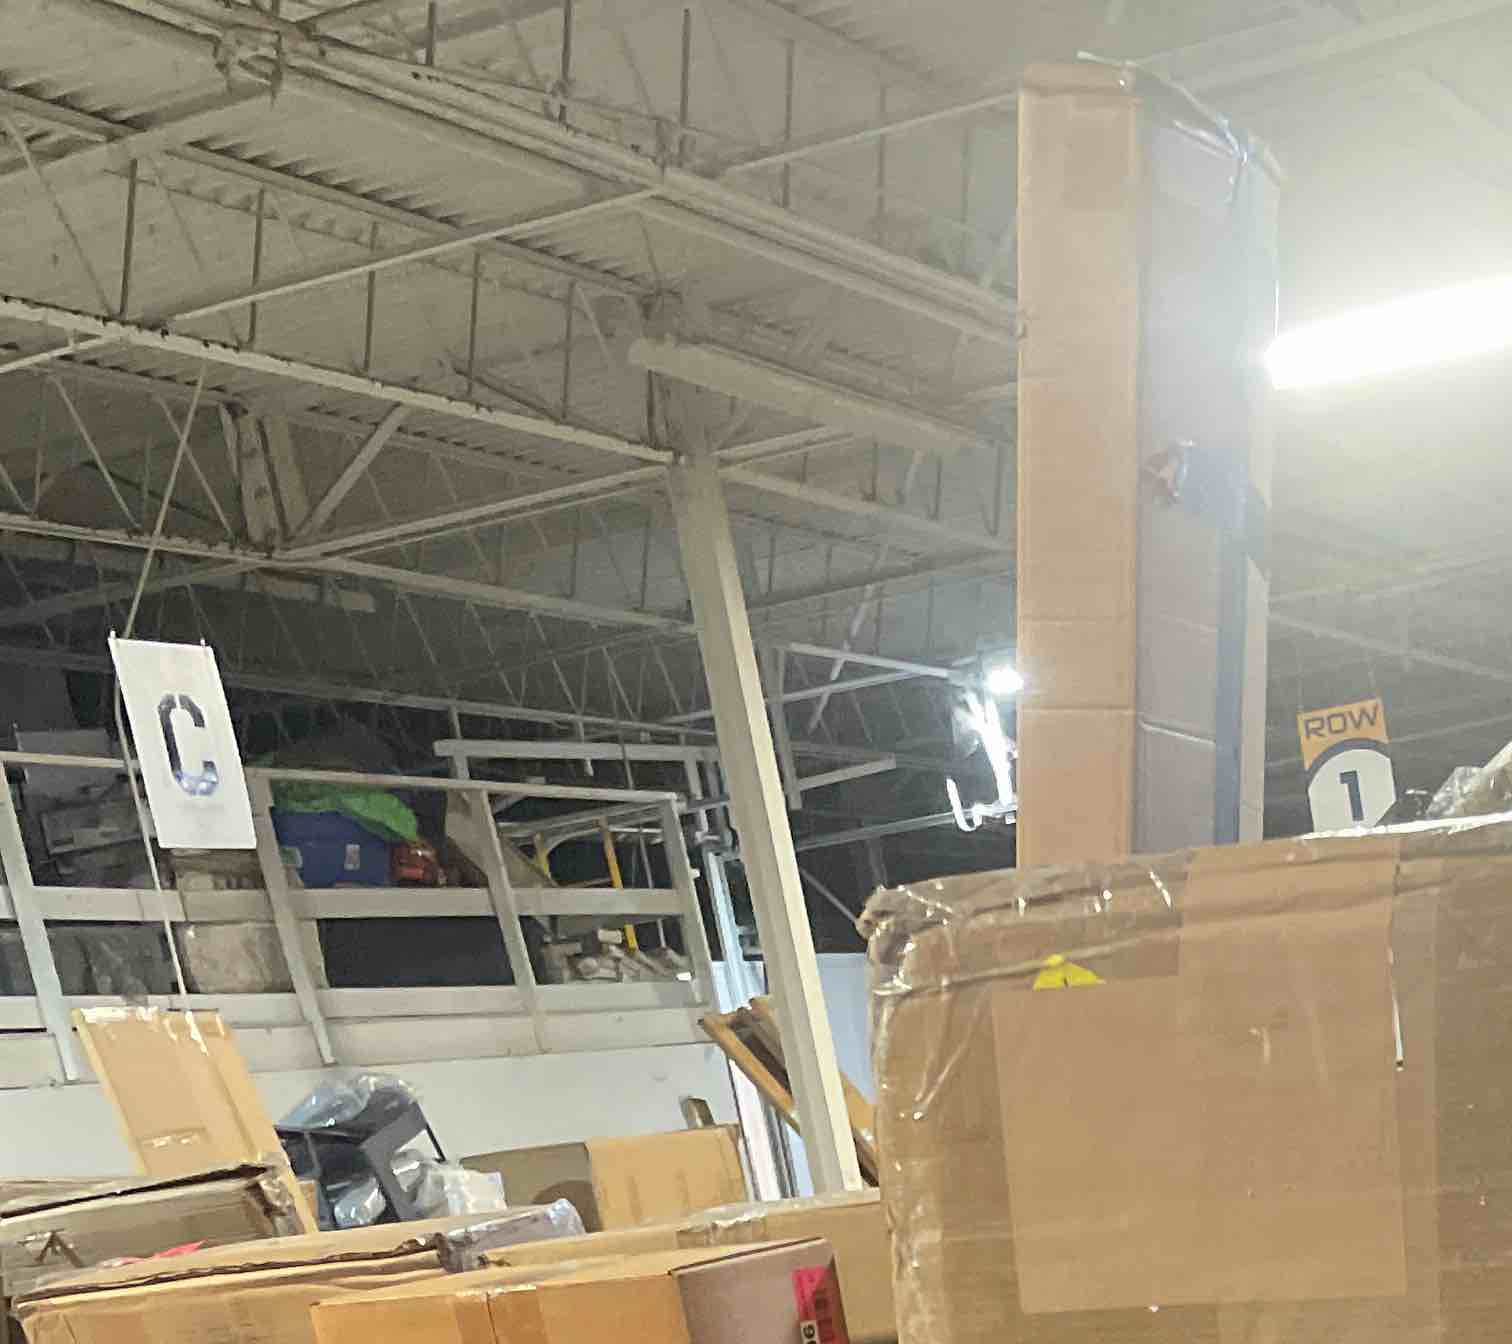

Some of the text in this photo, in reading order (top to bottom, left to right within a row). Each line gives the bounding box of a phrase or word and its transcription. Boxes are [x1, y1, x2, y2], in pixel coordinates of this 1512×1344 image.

[157, 693, 220, 797] C
[1304, 706, 1379, 739] ROW
[1339, 769, 1365, 822] 1
